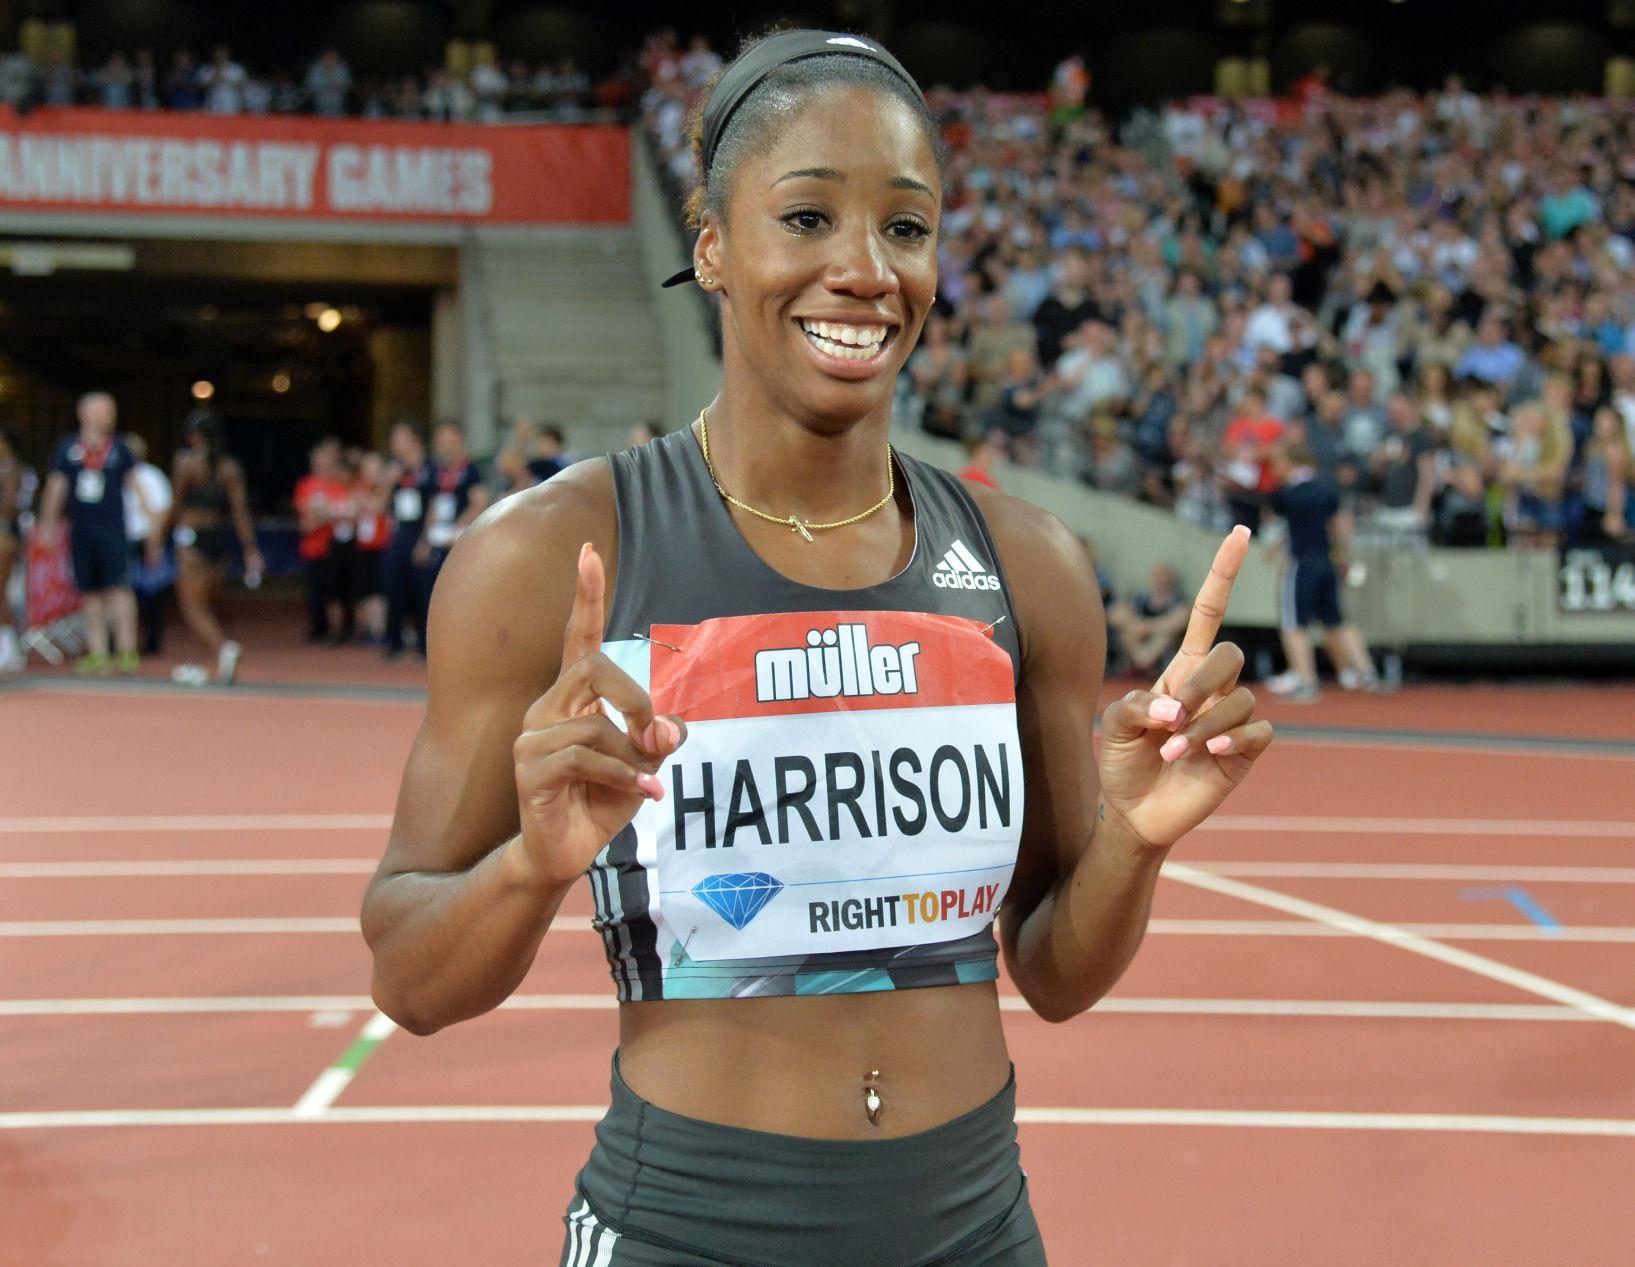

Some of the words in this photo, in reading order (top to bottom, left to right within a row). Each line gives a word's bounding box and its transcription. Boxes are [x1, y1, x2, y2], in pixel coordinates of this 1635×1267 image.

[0, 132, 321, 209] ANNIVERSARY
[327, 143, 494, 214] GAMES
[932, 569, 1001, 591] adidas
[754, 622, 921, 703] müller
[671, 742, 1011, 851] HARRISON
